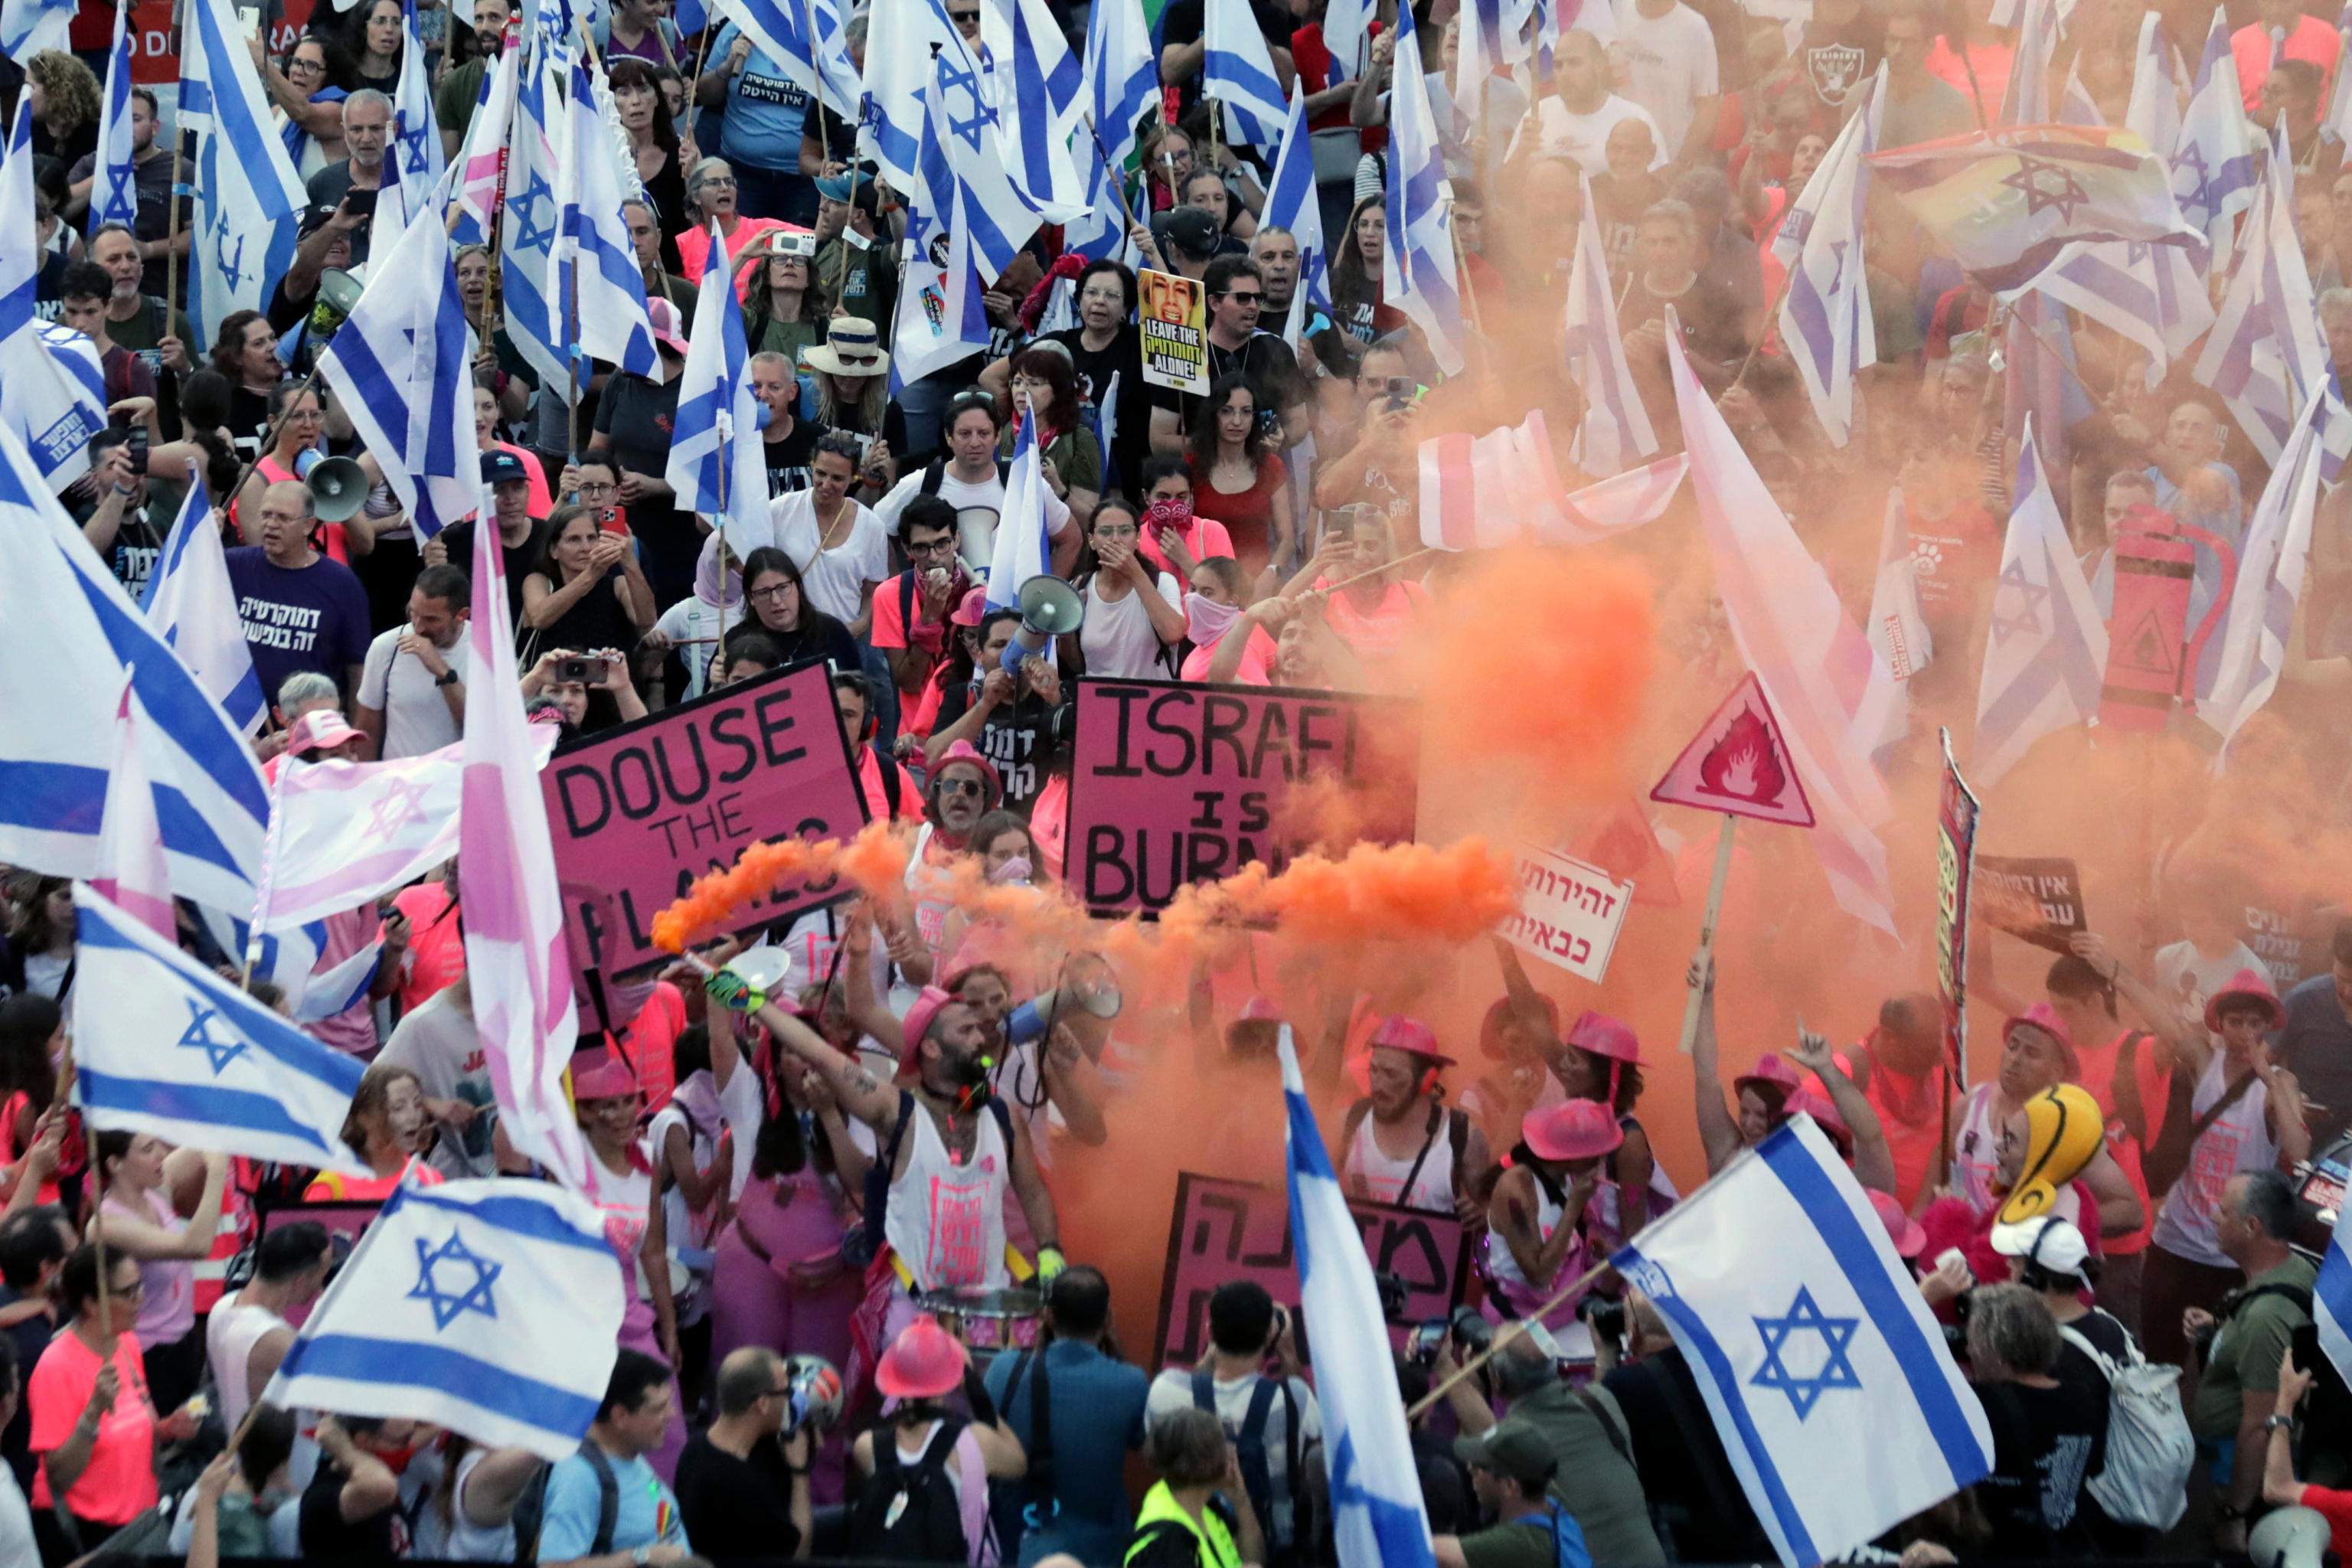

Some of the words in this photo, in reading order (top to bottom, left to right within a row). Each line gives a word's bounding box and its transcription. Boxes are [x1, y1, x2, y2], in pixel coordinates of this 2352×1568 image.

[741, 84, 779, 103] הייטק
[746, 74, 790, 90] דמוקרטיה
[782, 93, 803, 106] אין
[1147, 318, 1178, 341] LEAVE
[1179, 327, 1199, 347] THE
[1155, 354, 1196, 381] ALONE!
[240, 596, 321, 629] דמוקרטיה
[292, 630, 317, 652] זה
[557, 689, 807, 838] DOUSE
[648, 792, 753, 859] THE
[1191, 792, 1269, 832] IS
[580, 818, 839, 966] FLAES
[1521, 859, 1616, 919] זהירות!
[2038, 875, 2070, 900] אין
[2040, 903, 2075, 926] עם
